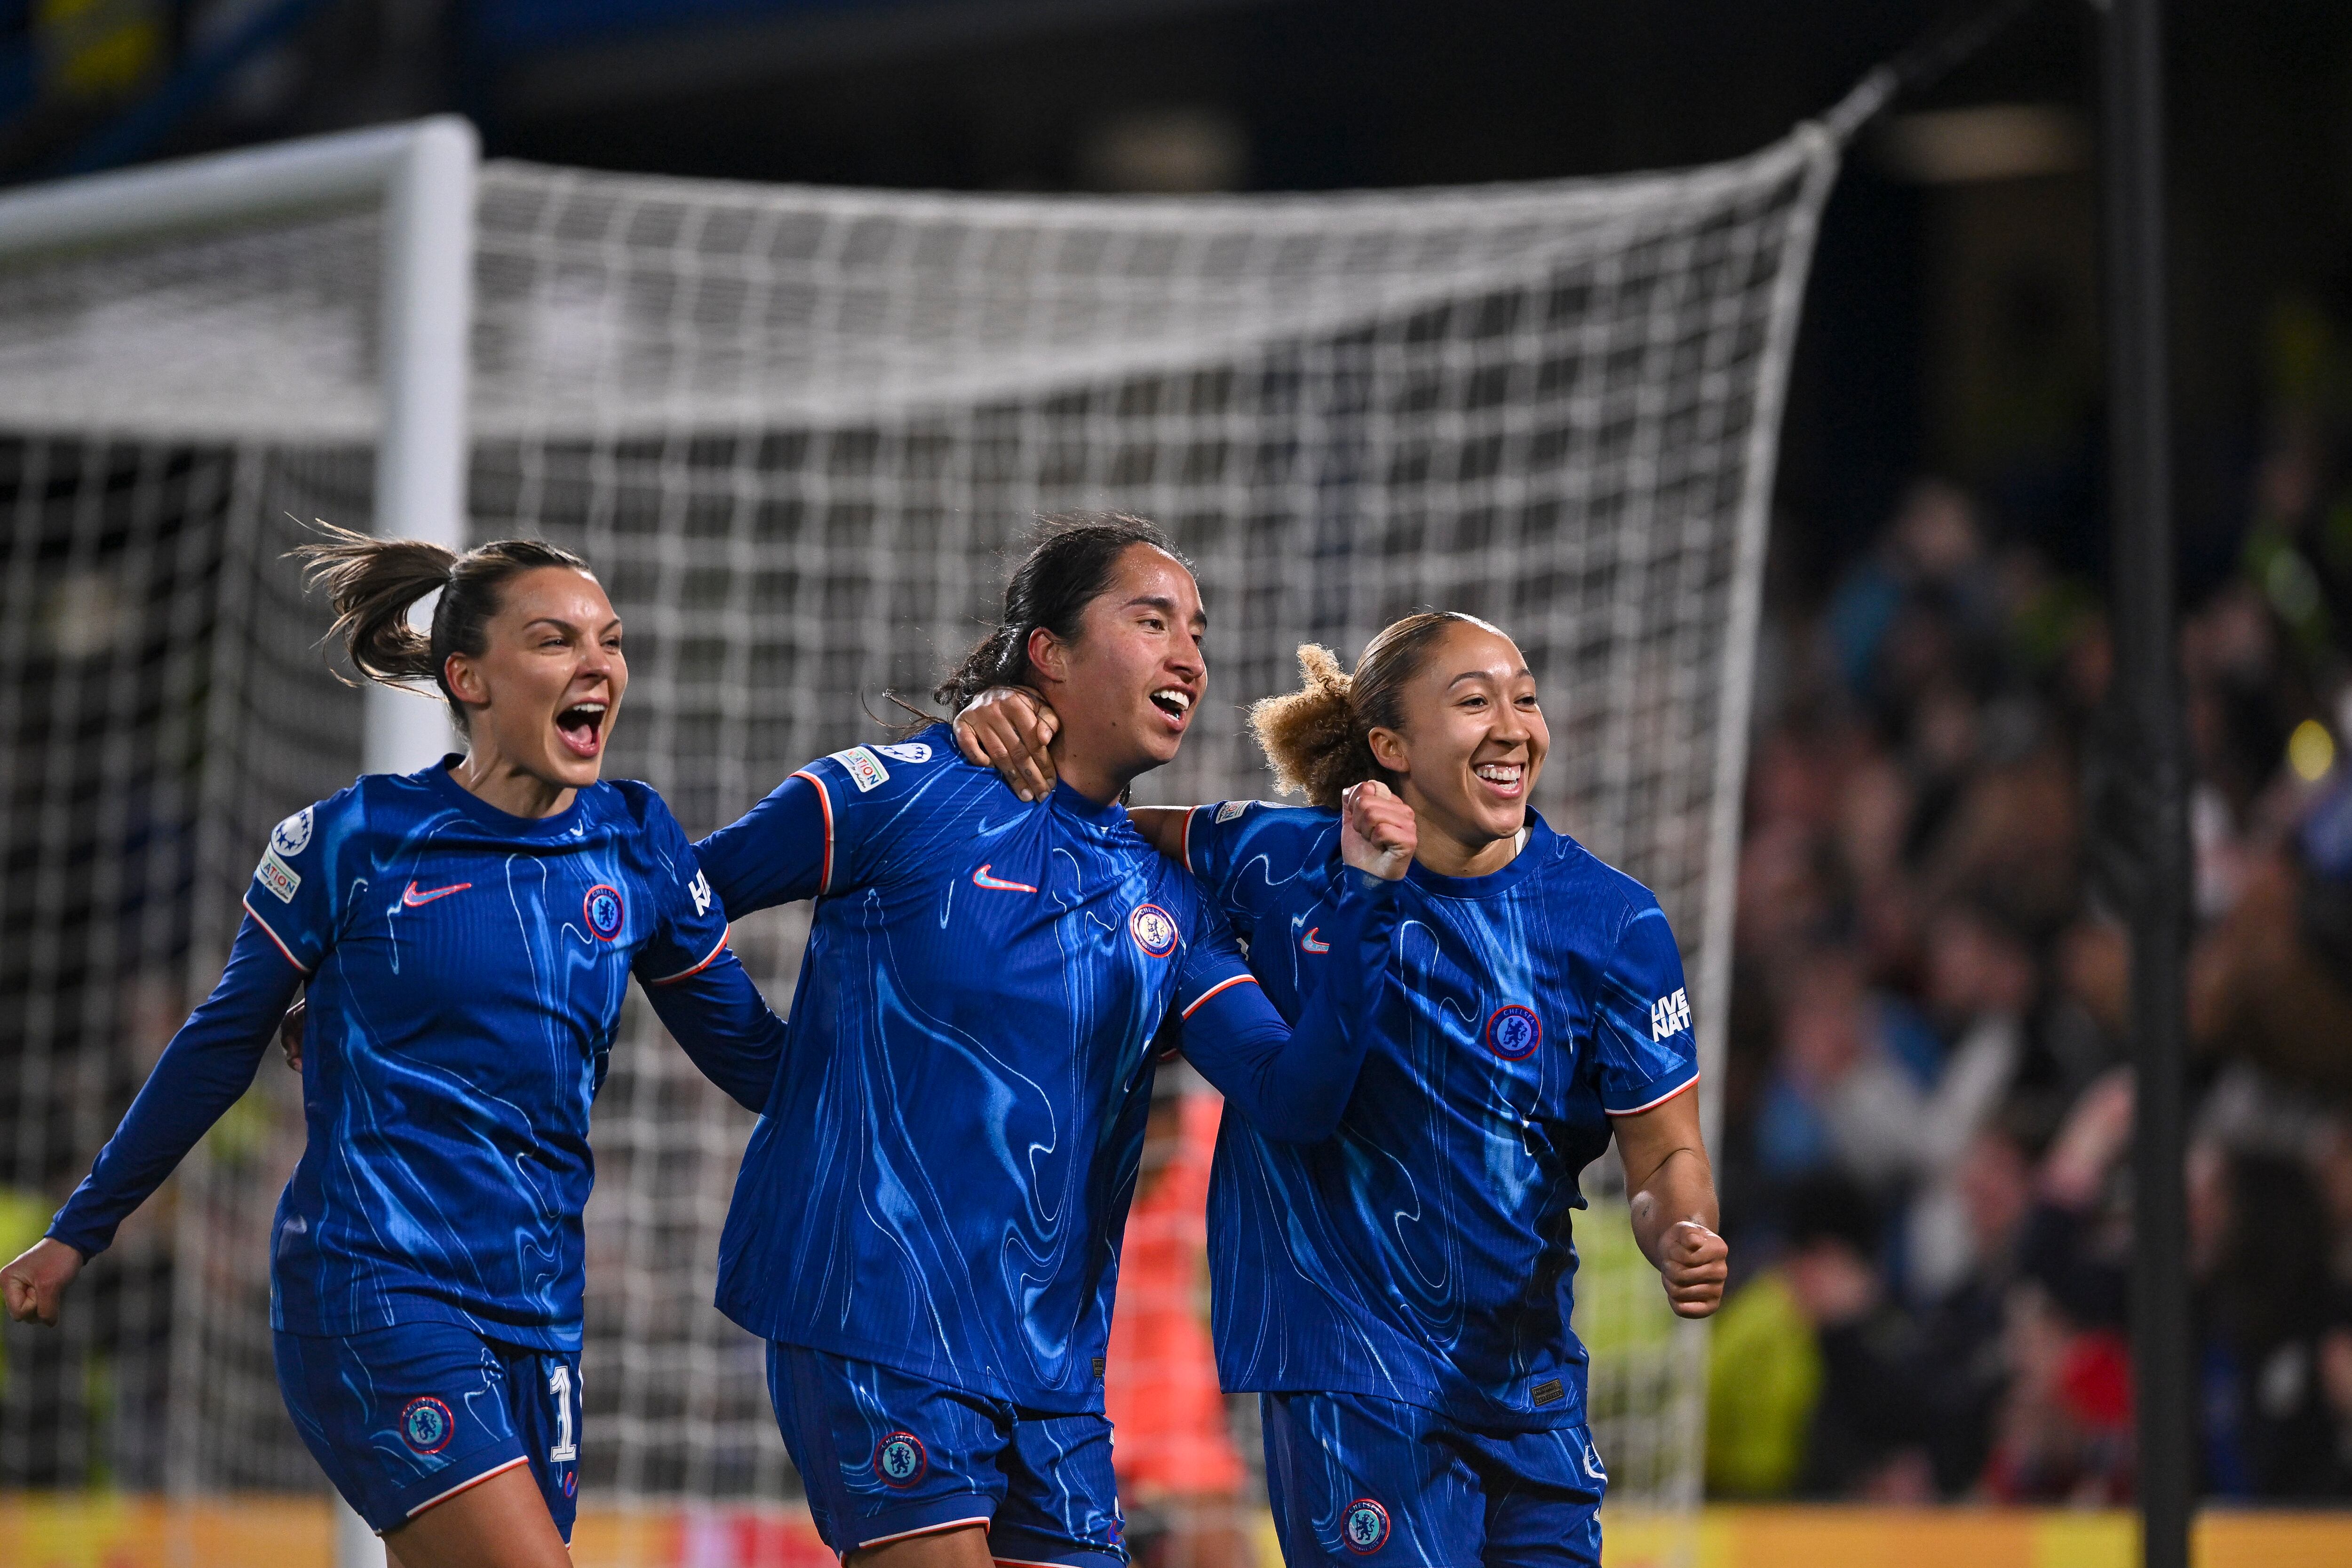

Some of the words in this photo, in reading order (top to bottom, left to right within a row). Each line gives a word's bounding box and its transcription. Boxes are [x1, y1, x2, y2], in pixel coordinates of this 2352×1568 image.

[263, 862, 296, 893] ATION
[1503, 1008, 1535, 1024] CHELSEA
[1651, 987, 1687, 1023] LIVE
[1652, 1004, 1692, 1043] NAT
[550, 1365, 583, 1462] 1
[1349, 1502, 1379, 1513] CHELSEA
